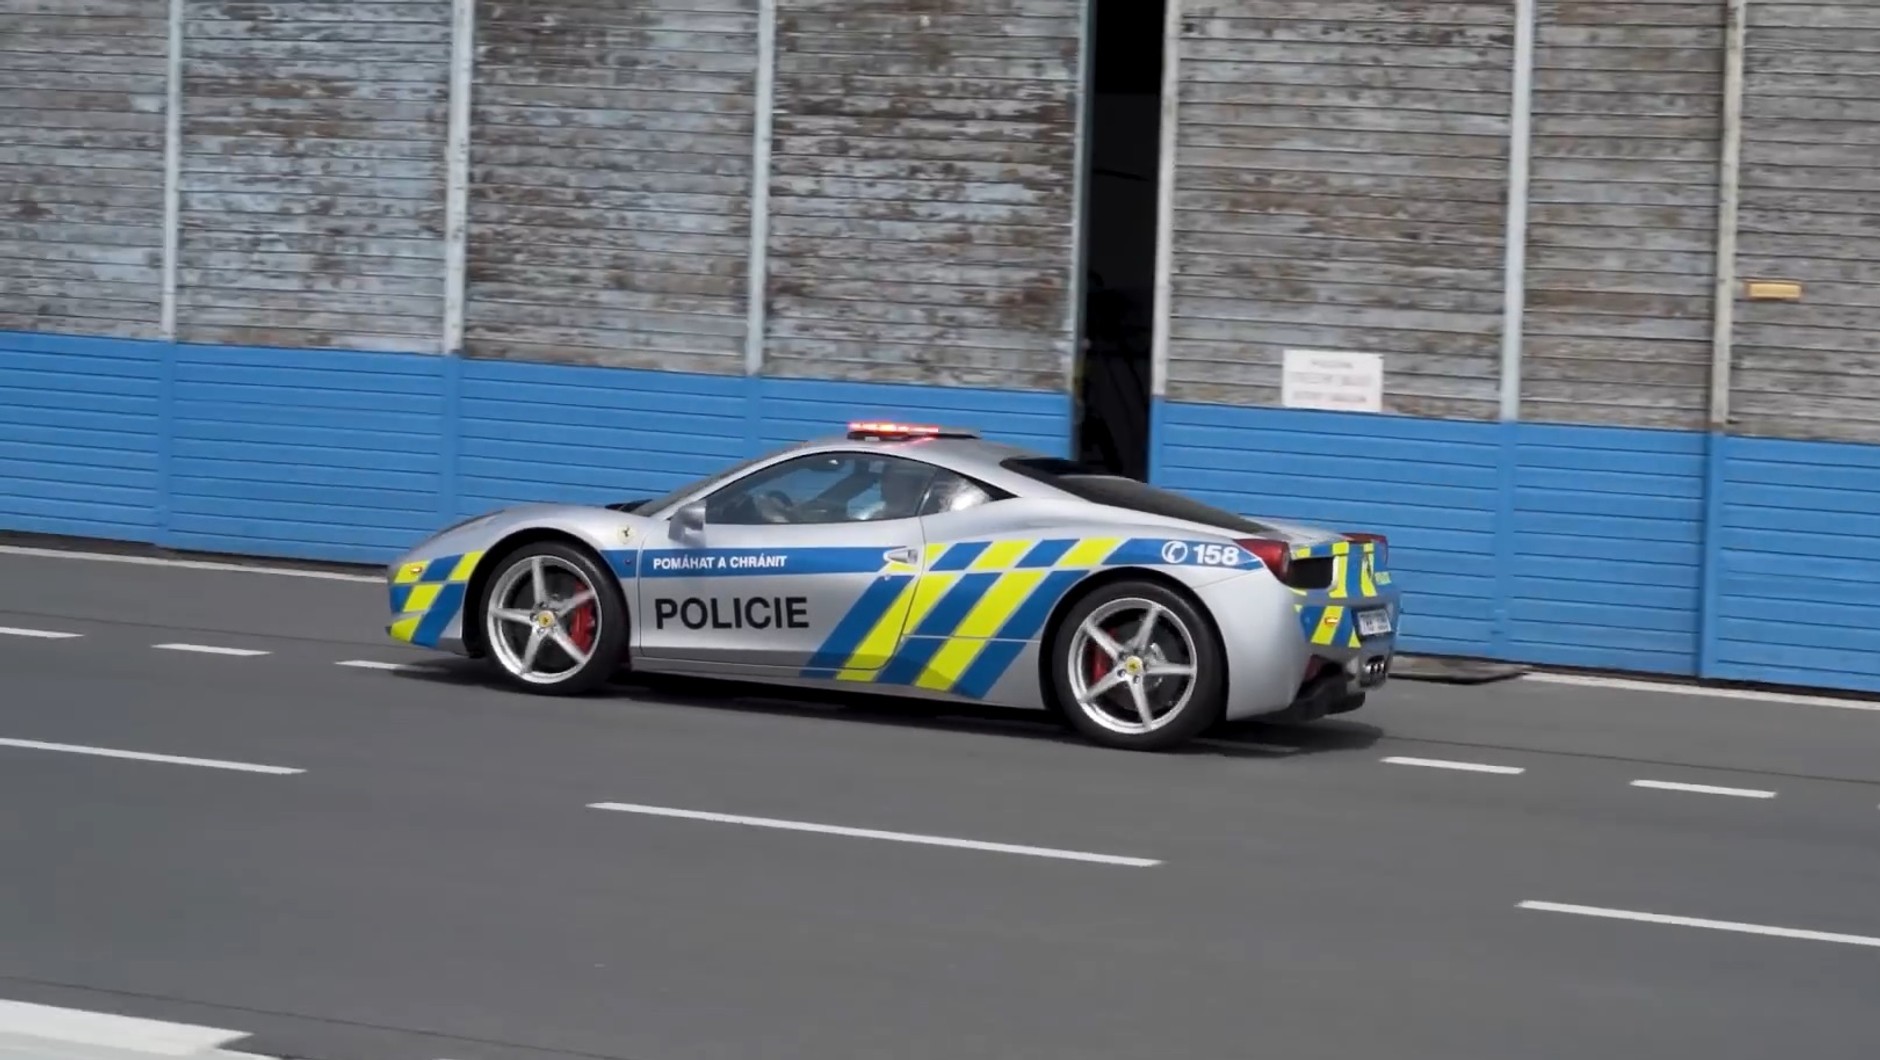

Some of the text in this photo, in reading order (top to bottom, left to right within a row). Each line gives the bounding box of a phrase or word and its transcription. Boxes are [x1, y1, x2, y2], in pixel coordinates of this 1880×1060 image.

[653, 553, 787, 570] POMÁHAT A CHRÁNIT
[1193, 544, 1239, 566] 158
[655, 597, 809, 630] POLICIE
